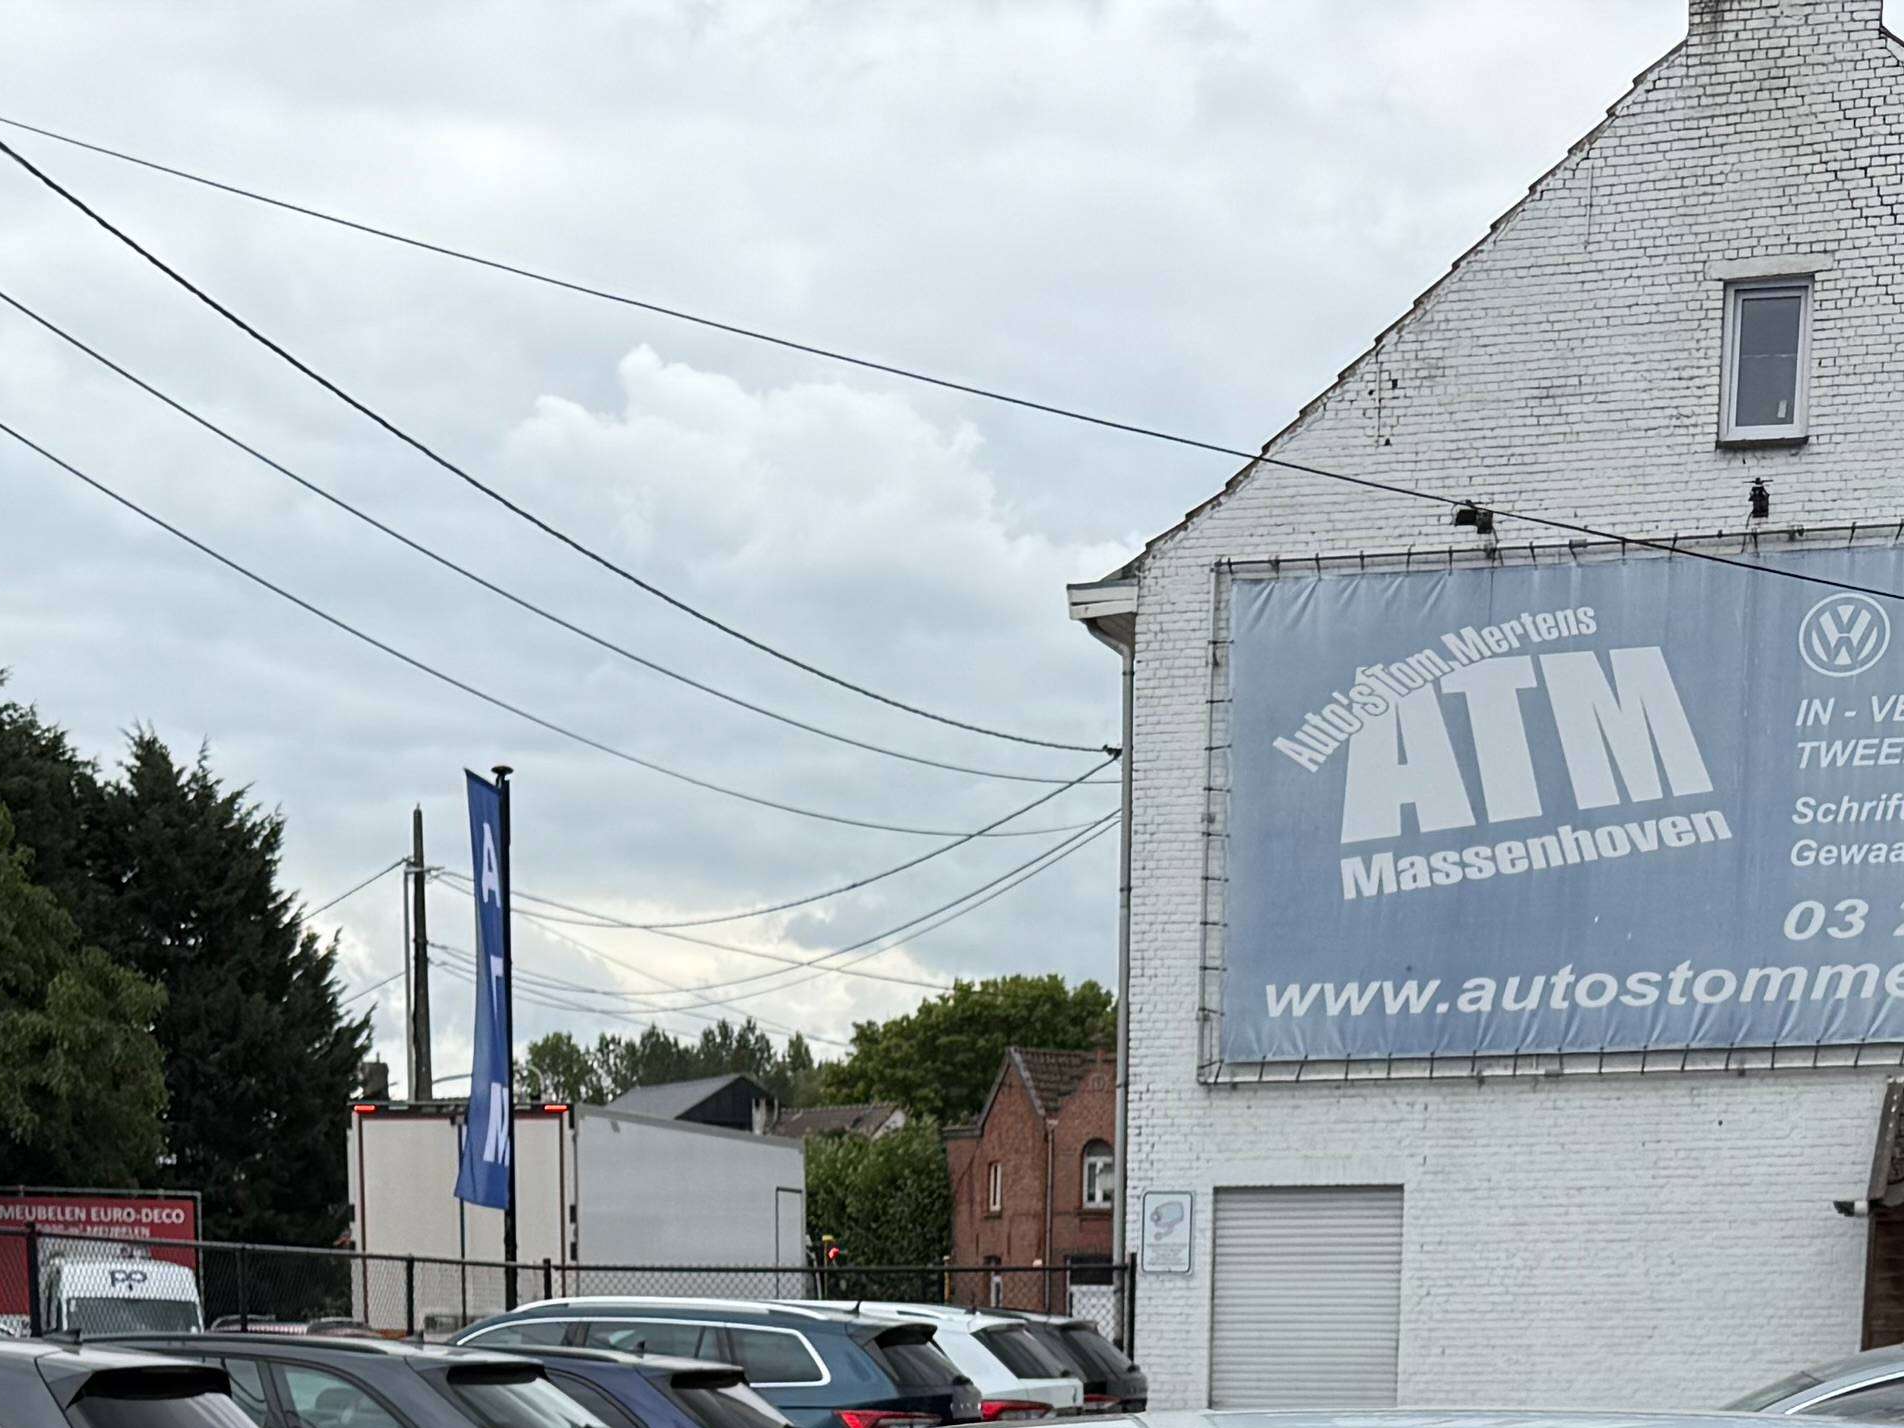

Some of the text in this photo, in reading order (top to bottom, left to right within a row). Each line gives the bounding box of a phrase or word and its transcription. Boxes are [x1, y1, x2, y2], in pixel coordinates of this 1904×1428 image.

[1272, 606, 1597, 773] Auto's Tom Mertens
[1795, 698, 1834, 727] IN
[1341, 646, 1714, 844] ATM
[1340, 808, 1733, 900] Massenhoven
[1782, 898, 1870, 940] 03
[90, 1207, 185, 1224] EURO-DECO
